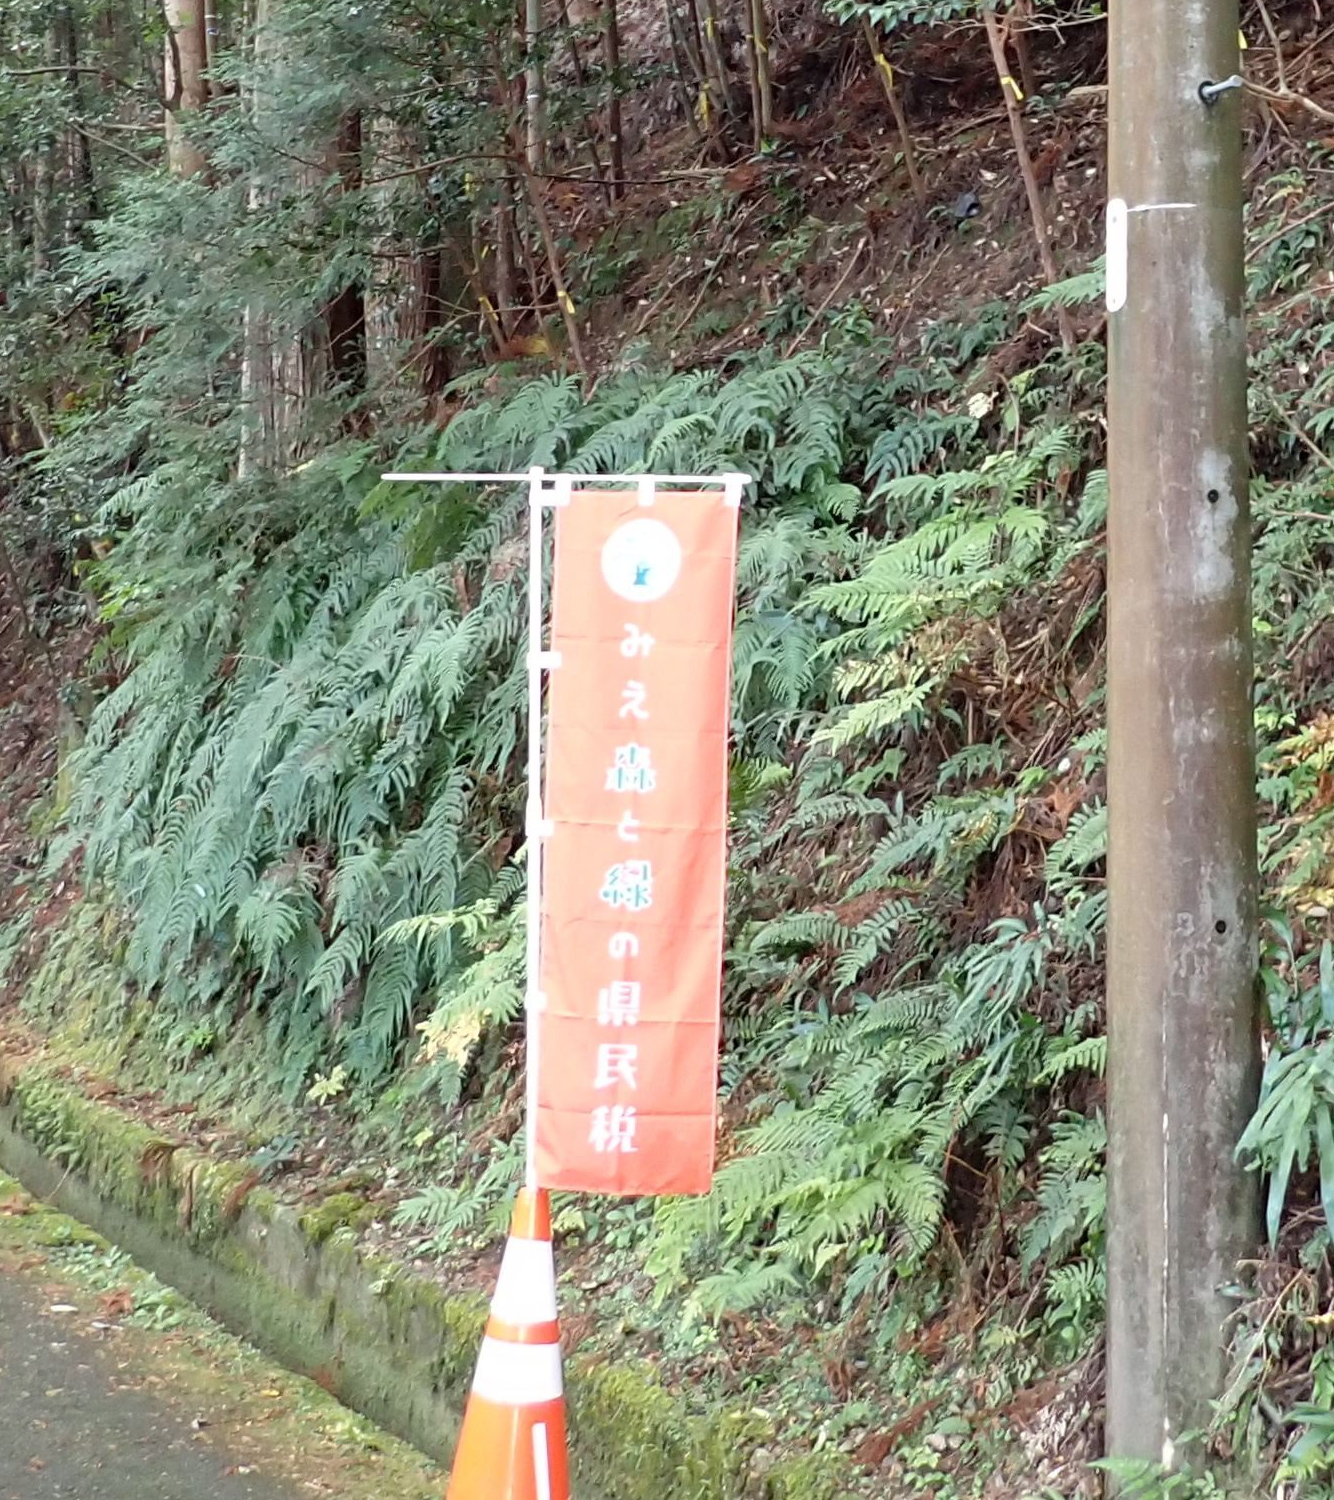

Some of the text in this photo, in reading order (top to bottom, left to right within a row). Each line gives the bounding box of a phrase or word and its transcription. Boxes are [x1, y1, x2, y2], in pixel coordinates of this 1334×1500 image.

[588, 623, 656, 1154] みえ森と緑の県民税
